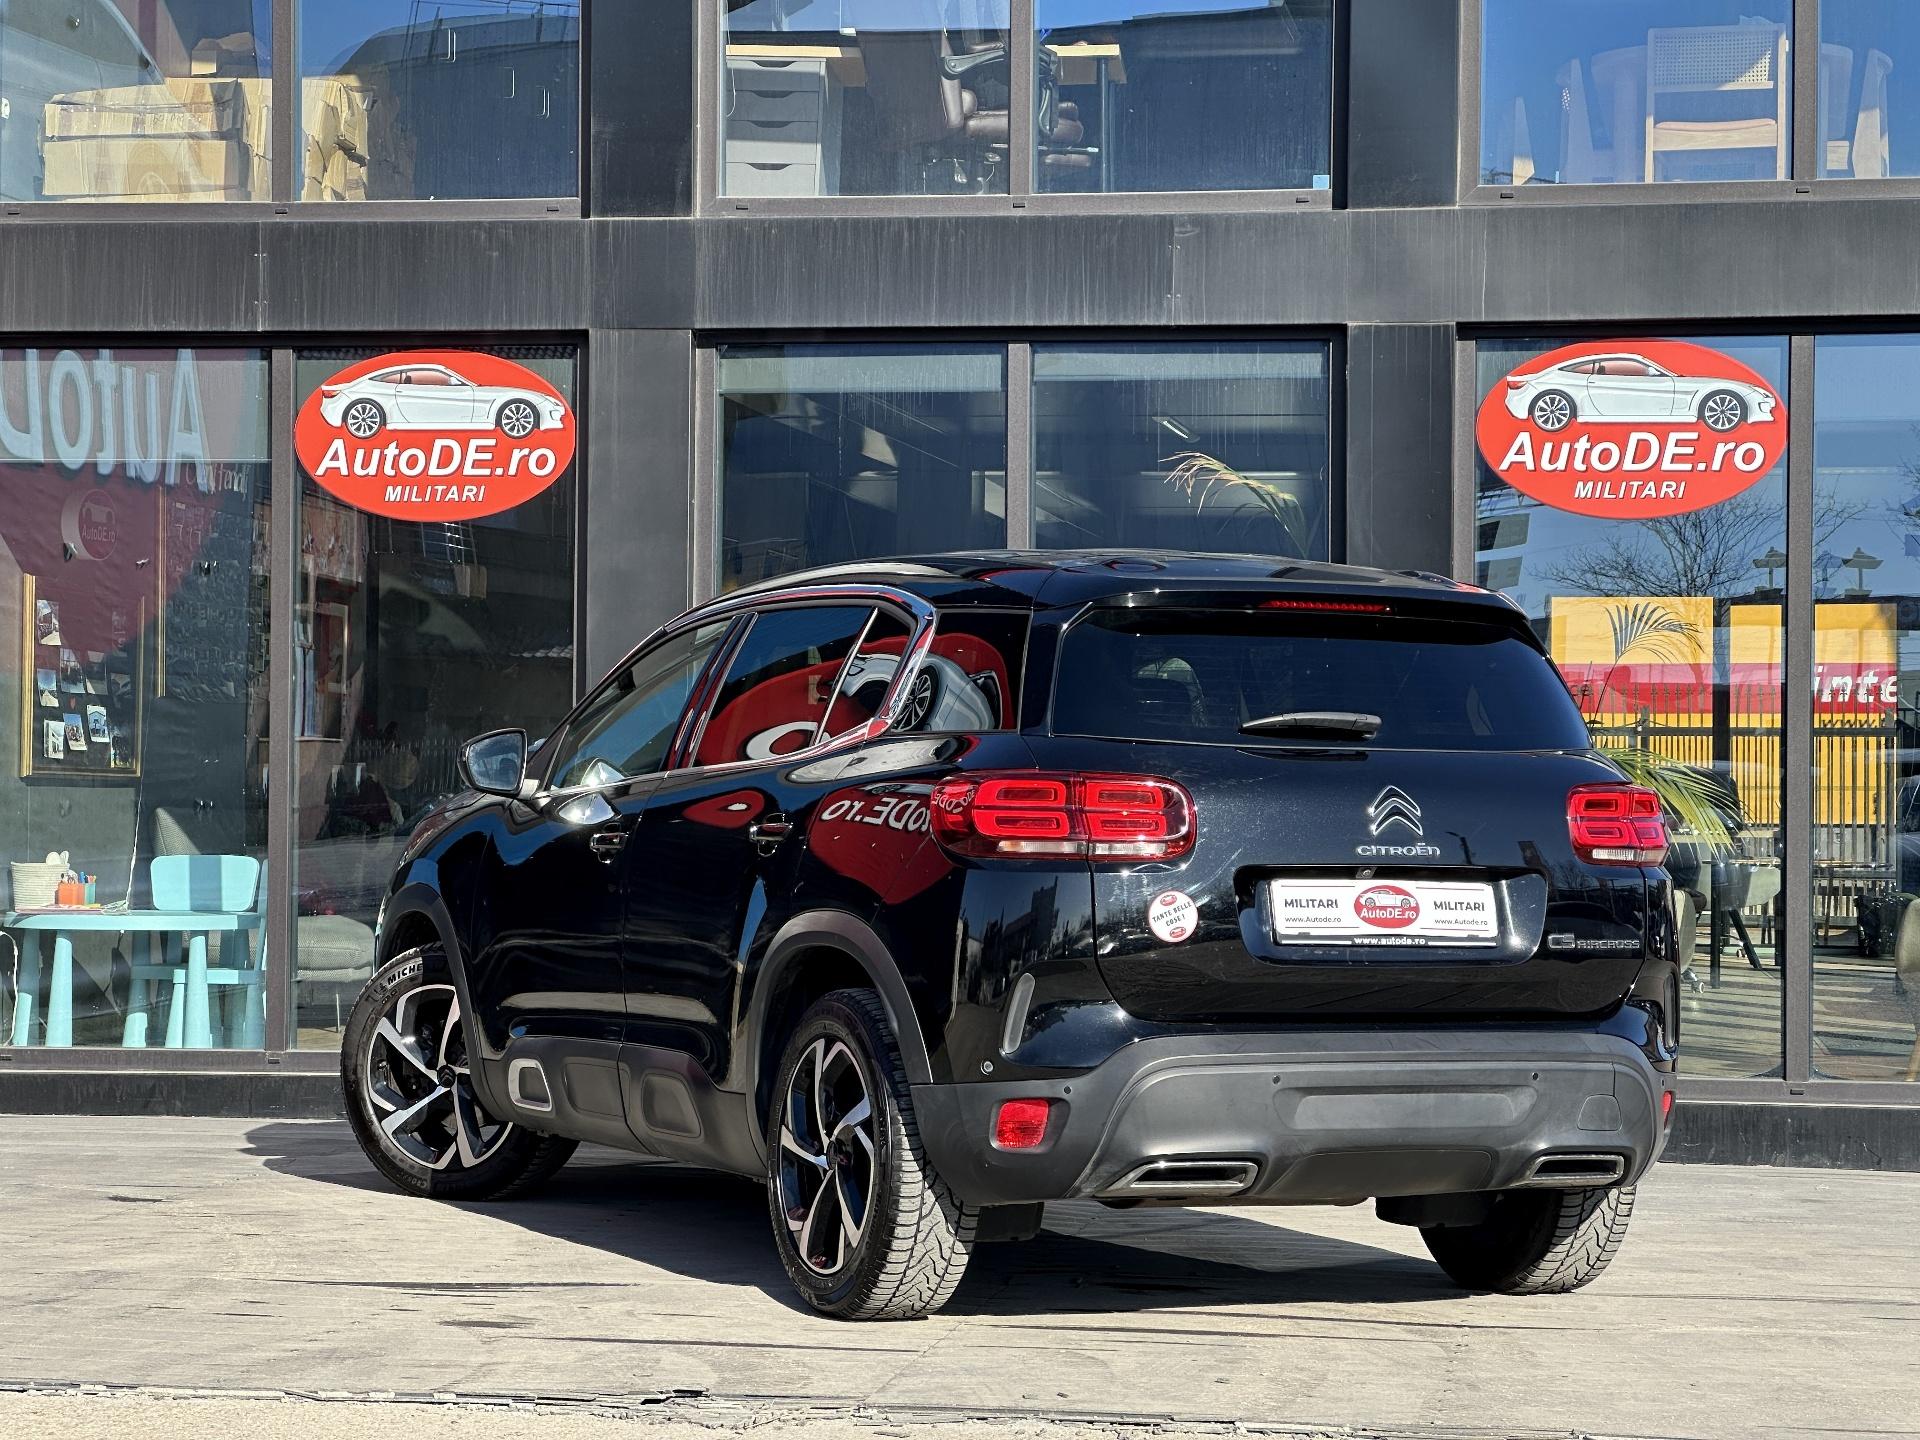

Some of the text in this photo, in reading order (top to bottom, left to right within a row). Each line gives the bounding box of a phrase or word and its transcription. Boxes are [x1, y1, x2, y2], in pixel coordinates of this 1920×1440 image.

[315, 438, 556, 477] AutoDE.ro
[1499, 431, 1765, 472] AutoDE.ro
[384, 485, 486, 502] MILITARI
[1573, 481, 1686, 499] MILITARI
[1284, 898, 1339, 909] MILITARI
[1433, 900, 1485, 912] MILITARI
[1152, 900, 1192, 923] TANTE BELLE
[1360, 908, 1417, 919] AutoDE.ro
[1434, 918, 1488, 926] www.Autode.ro
[1354, 937, 1426, 946] www.autode.ro
[1548, 934, 1640, 949] C5 AIRCROSS
